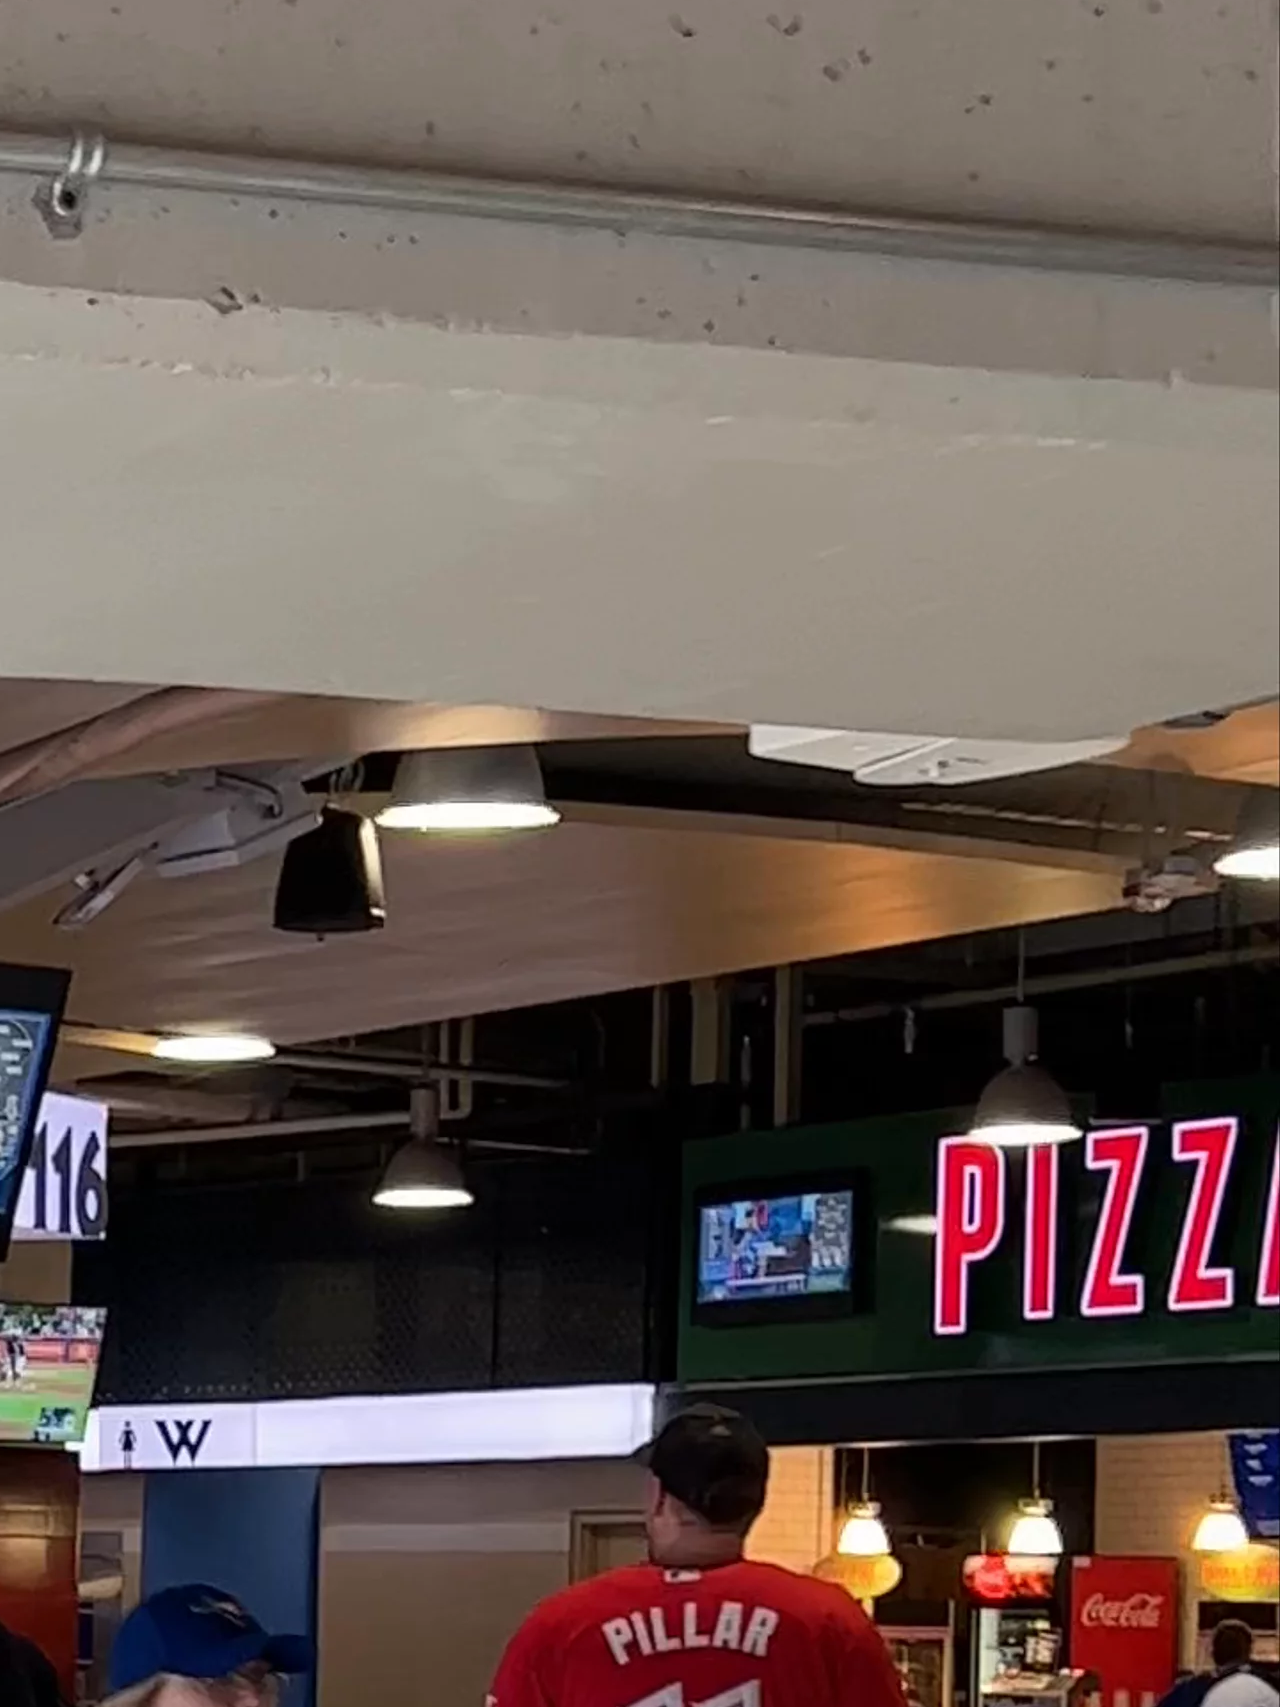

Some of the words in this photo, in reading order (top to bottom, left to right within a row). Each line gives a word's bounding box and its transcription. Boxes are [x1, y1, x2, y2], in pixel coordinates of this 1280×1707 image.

[27, 1121, 108, 1237] 116
[934, 1116, 1280, 1335] PIZZ
[155, 1419, 213, 1466] W
[601, 1600, 780, 1666] PILLAR
